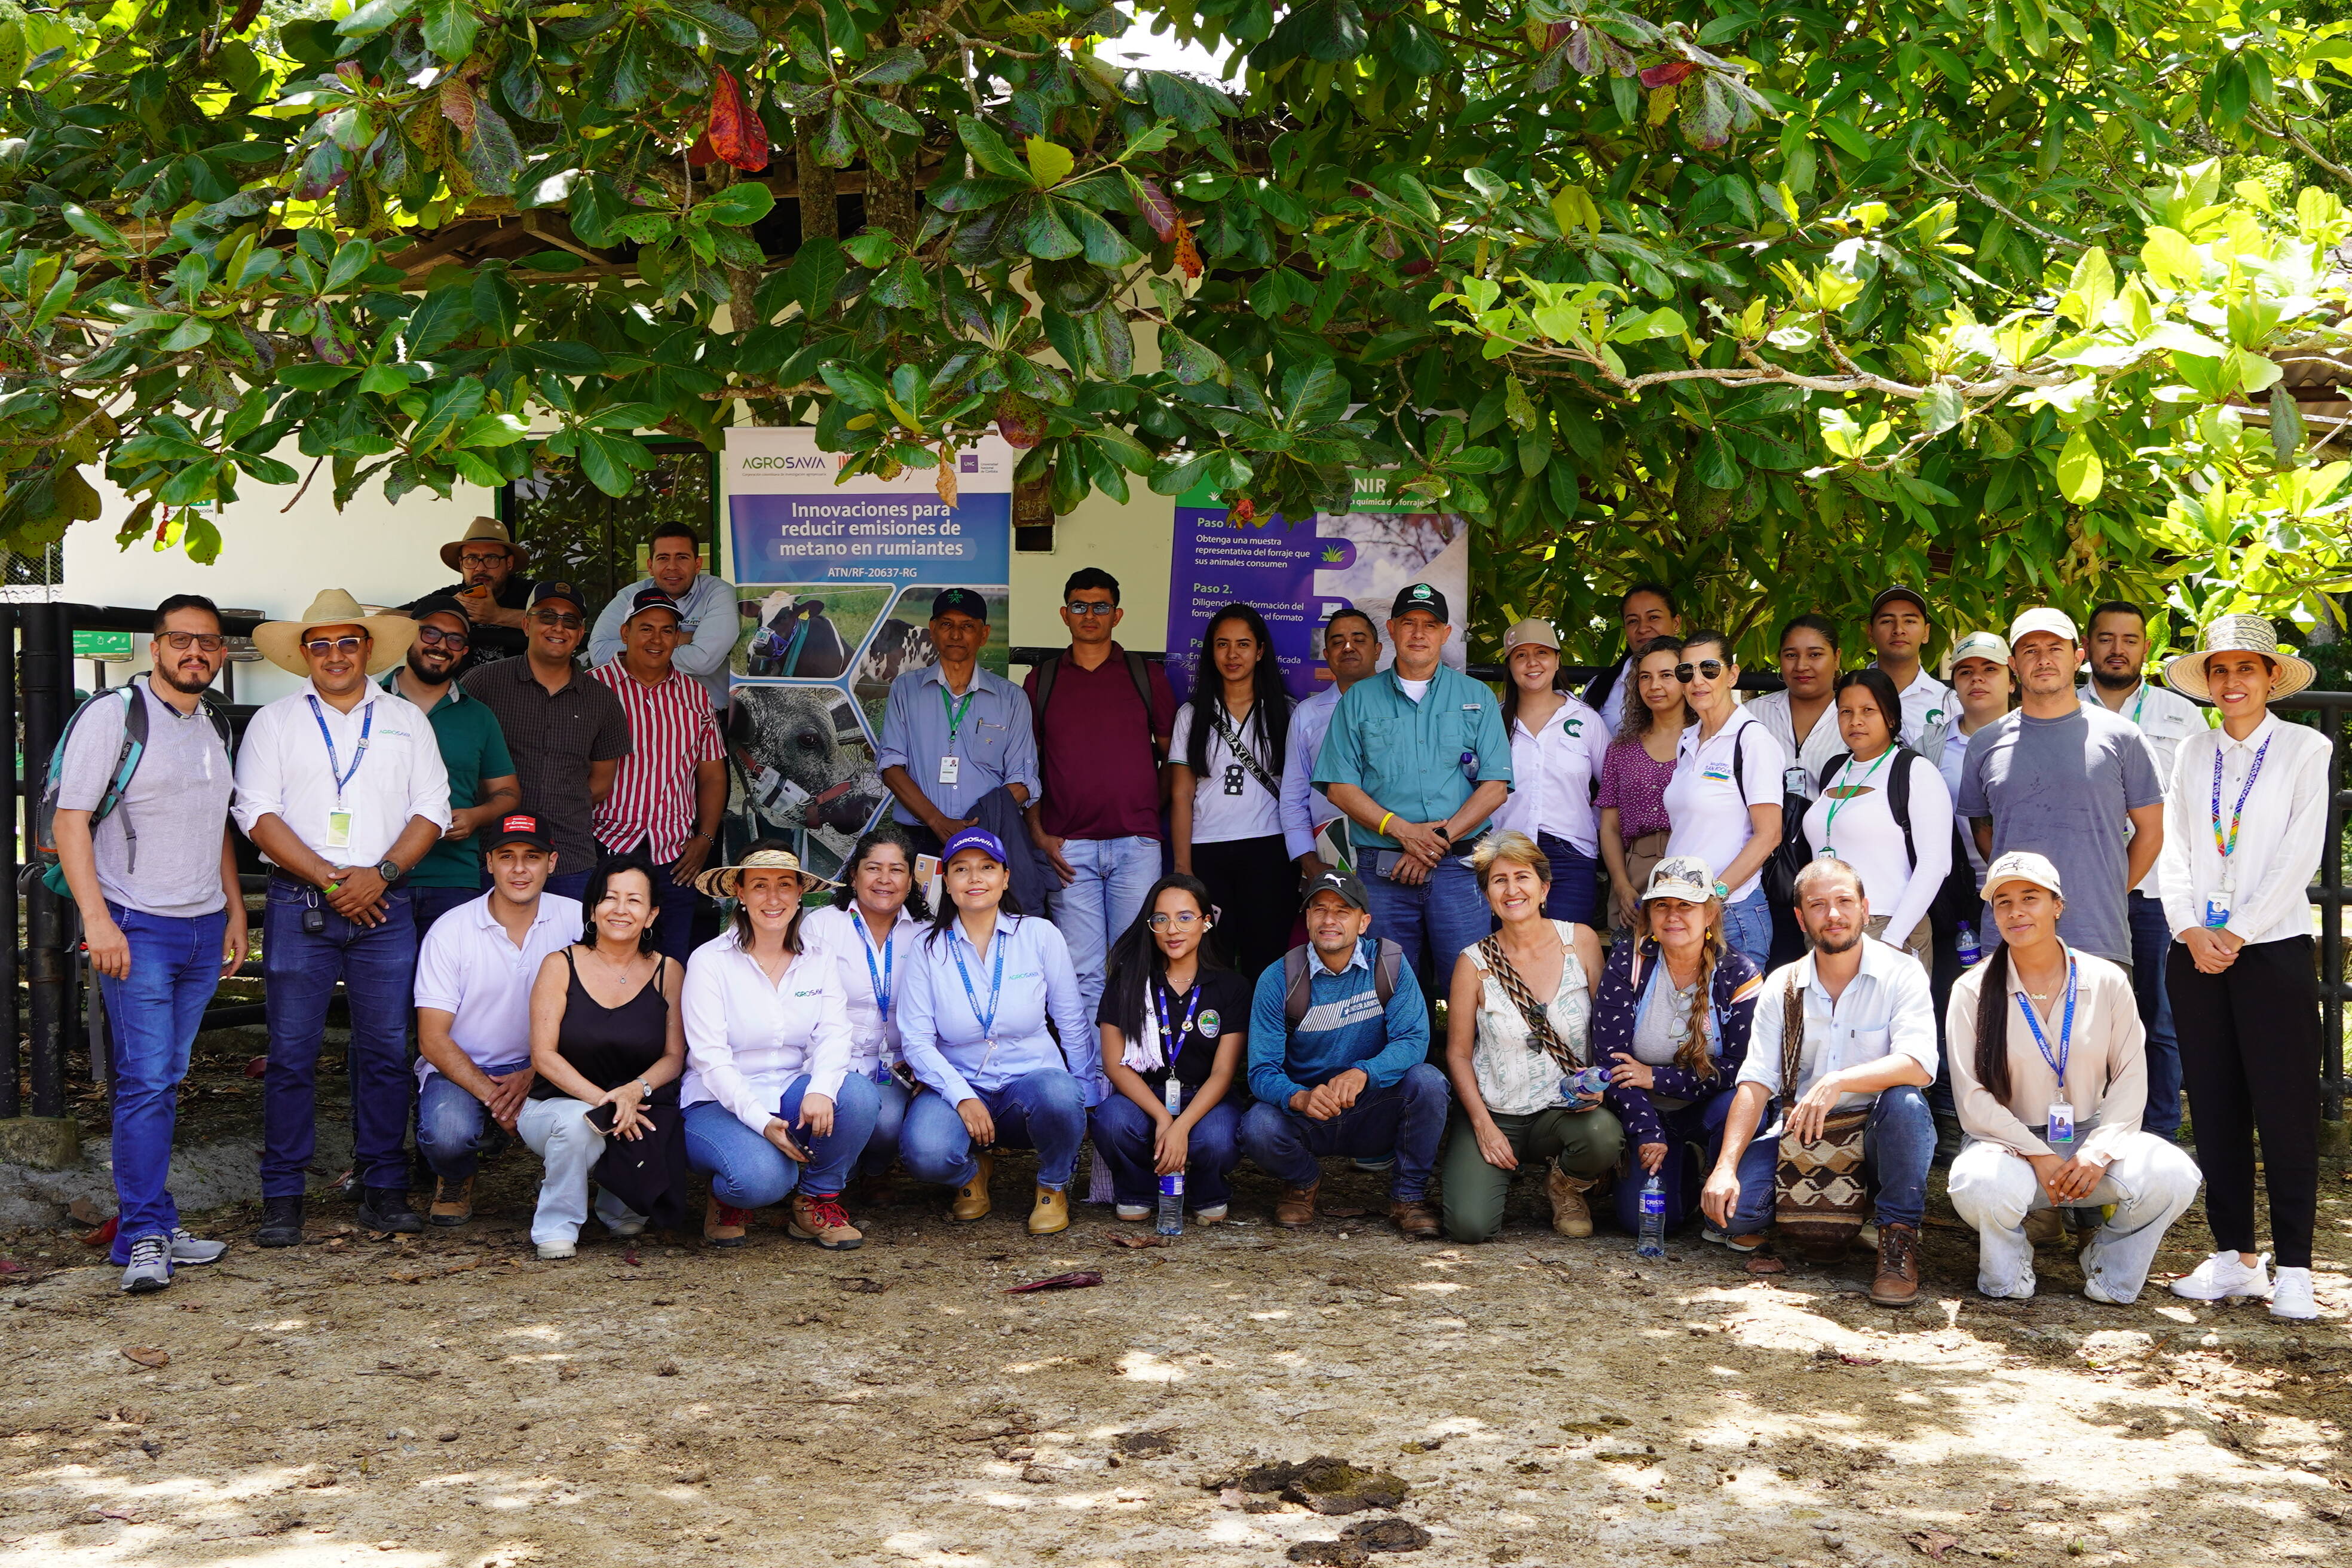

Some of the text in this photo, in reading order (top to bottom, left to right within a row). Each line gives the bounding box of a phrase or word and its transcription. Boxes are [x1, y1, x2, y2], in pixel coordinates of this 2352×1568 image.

[742, 457, 826, 469] AGROSAVIA
[1356, 498, 1386, 507] química
[1399, 499, 1425, 507] forraje
[792, 501, 950, 521] Innovaciones para
[782, 519, 961, 536] reducir emisiones de
[1197, 517, 1224, 528] Paso
[1196, 534, 1231, 545] Obtenga
[780, 539, 963, 556] metano en rumiantes
[1195, 546, 1252, 556] representativa
[1253, 548, 1266, 556] del
[1267, 548, 1293, 558] forraje
[1209, 558, 1245, 566] animales
[1246, 560, 1288, 568] consumen
[828, 567, 918, 578] ATN/RF-20637-RG
[1193, 583, 1233, 594] Paso 2.
[1192, 598, 1232, 608] Diligencie
[1291, 602, 1304, 611] del
[1192, 608, 1217, 618] forraje
[1272, 612, 1304, 622] formato
[952, 837, 994, 849] AGROSAVIA
[1008, 972, 1039, 980] AGROSAVIA
[2038, 1037, 2054, 1065] AGROSAVIA
